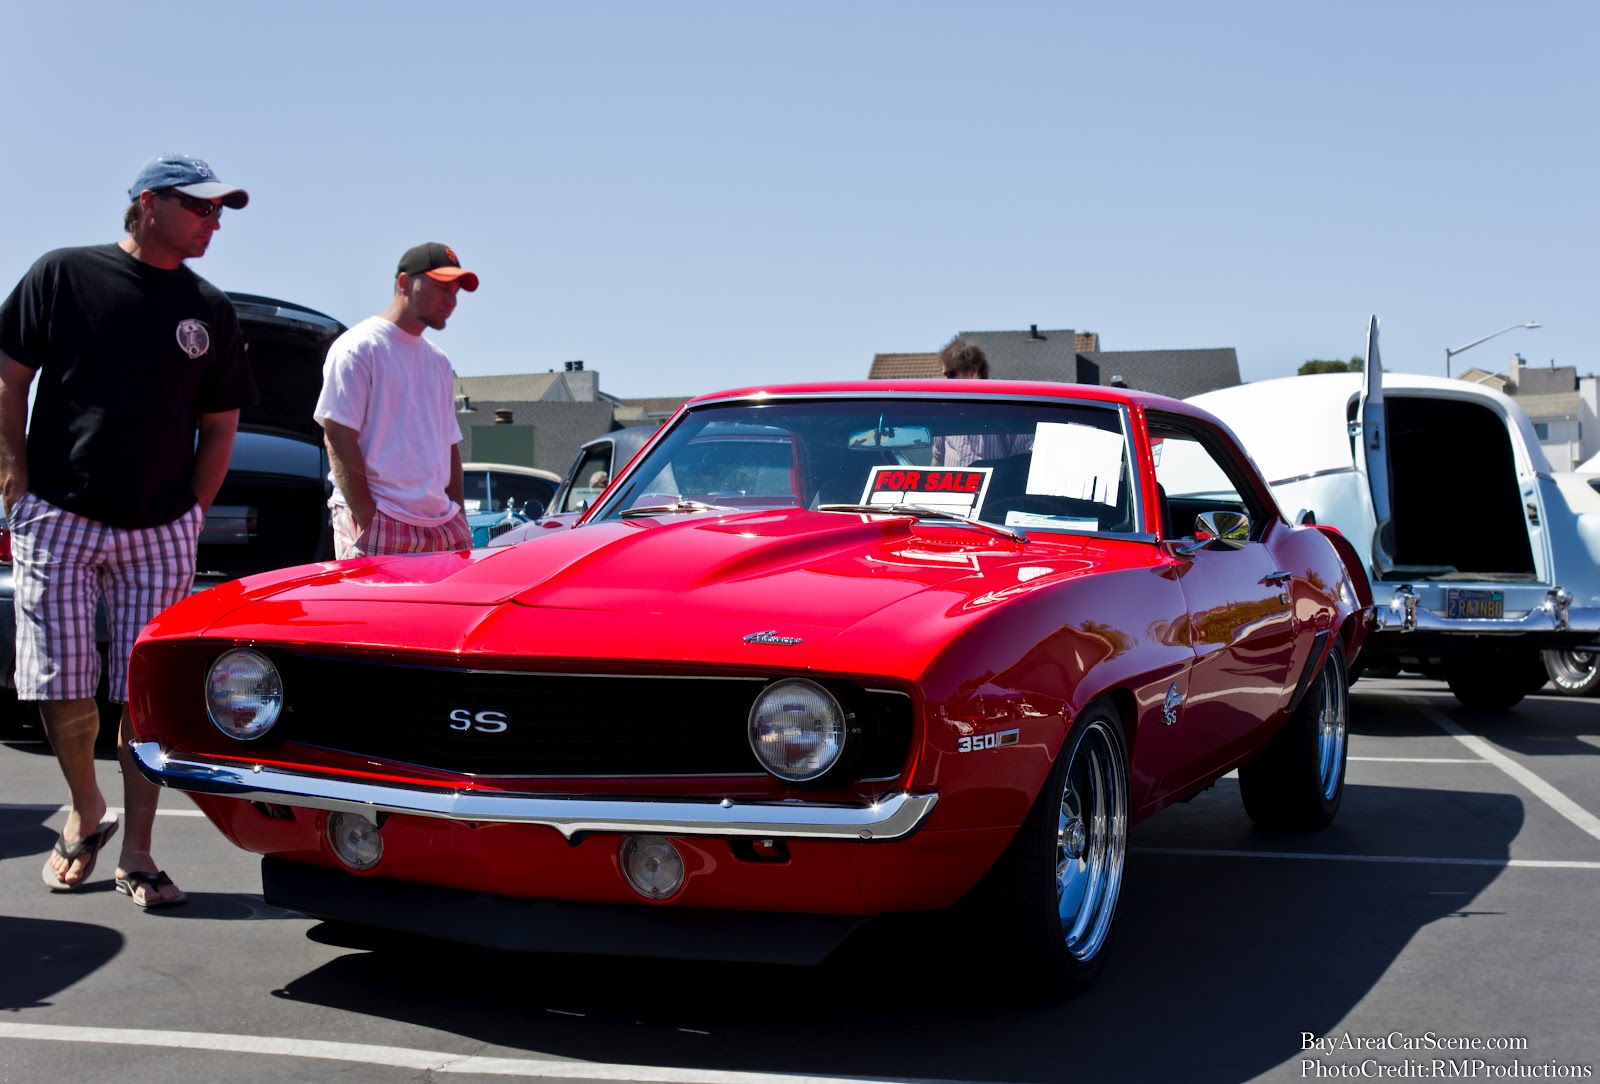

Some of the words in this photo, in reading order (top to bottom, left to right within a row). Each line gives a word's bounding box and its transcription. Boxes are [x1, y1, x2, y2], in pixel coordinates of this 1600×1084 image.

[874, 471, 921, 490] FOR
[924, 472, 982, 493] SALE
[449, 709, 508, 733] SS
[958, 733, 995, 753] 350
